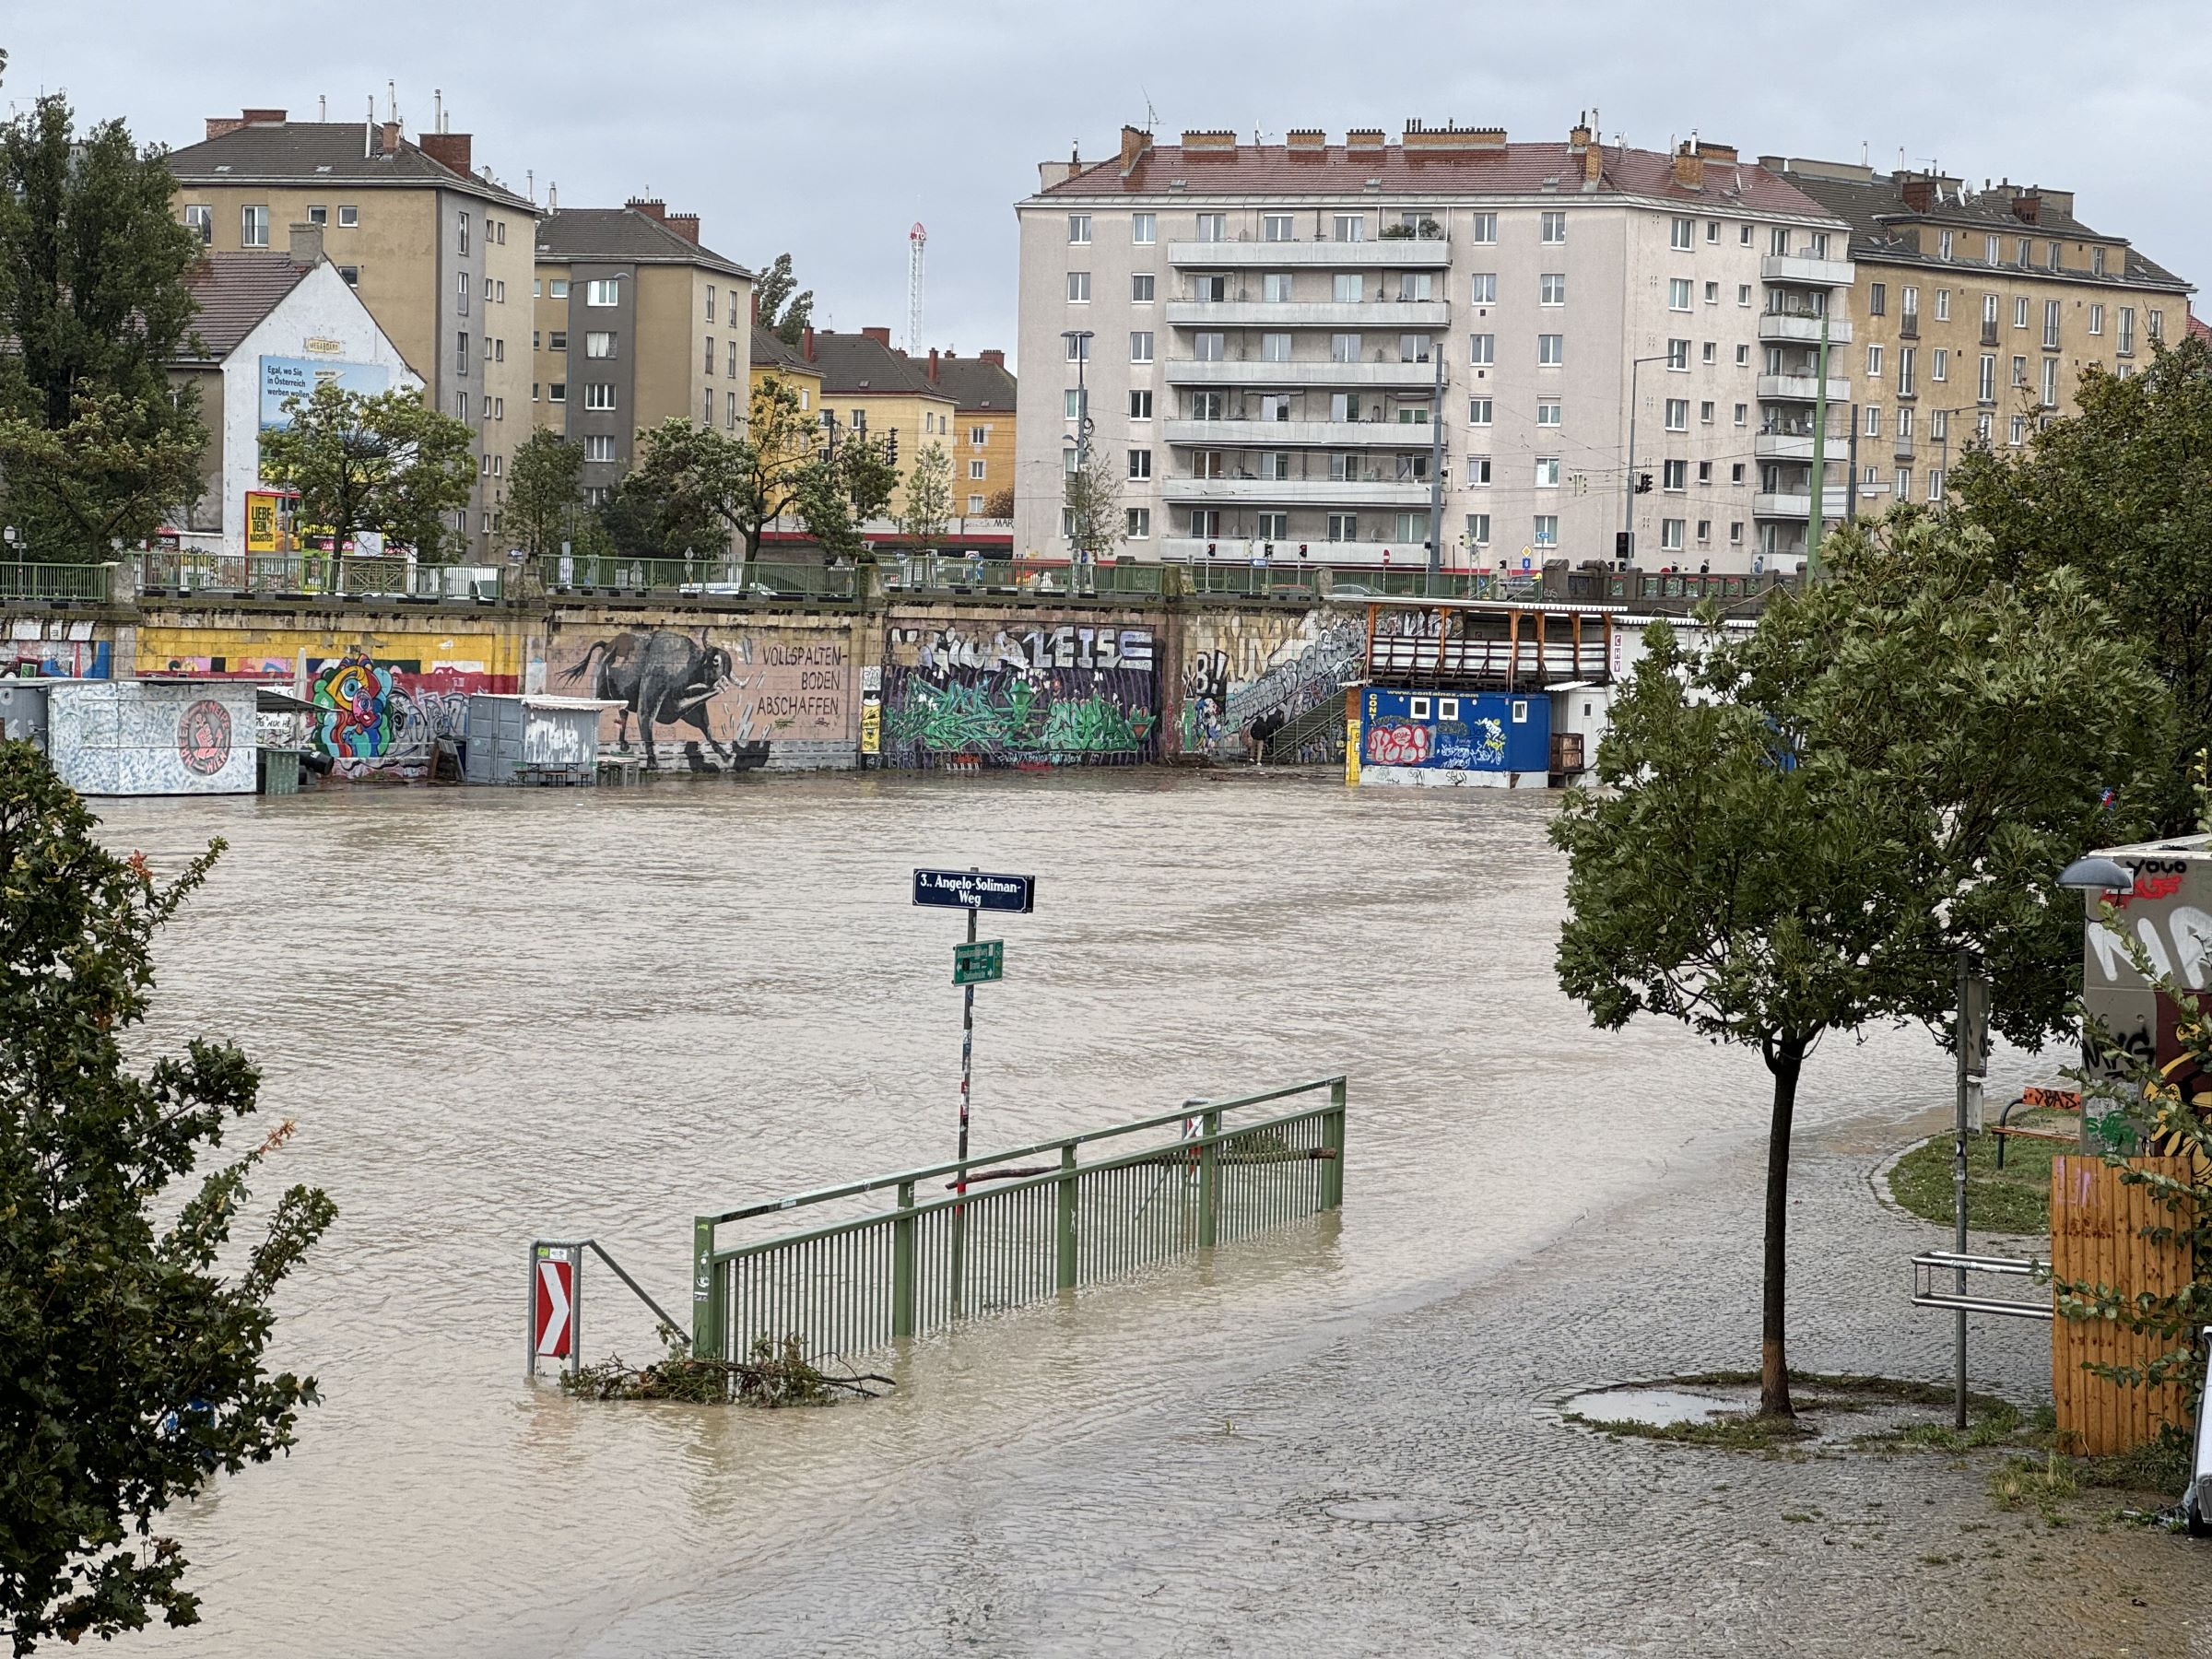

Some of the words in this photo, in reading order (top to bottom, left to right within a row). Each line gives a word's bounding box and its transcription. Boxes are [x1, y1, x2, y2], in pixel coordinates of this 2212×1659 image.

[267, 365, 282, 375] Egal,
[293, 368, 303, 376] Sie
[267, 376, 274, 384] in
[275, 375, 306, 387] Österreich
[267, 388, 289, 396] werben
[762, 646, 848, 666] VOLLSPALTEN-
[801, 670, 840, 690] BODEN
[1386, 689, 1479, 699] www.containex.com
[756, 697, 839, 717] ABSCHAFFEN
[935, 875, 1021, 893] Angelo-Soliman-
[959, 890, 981, 907] Weg
